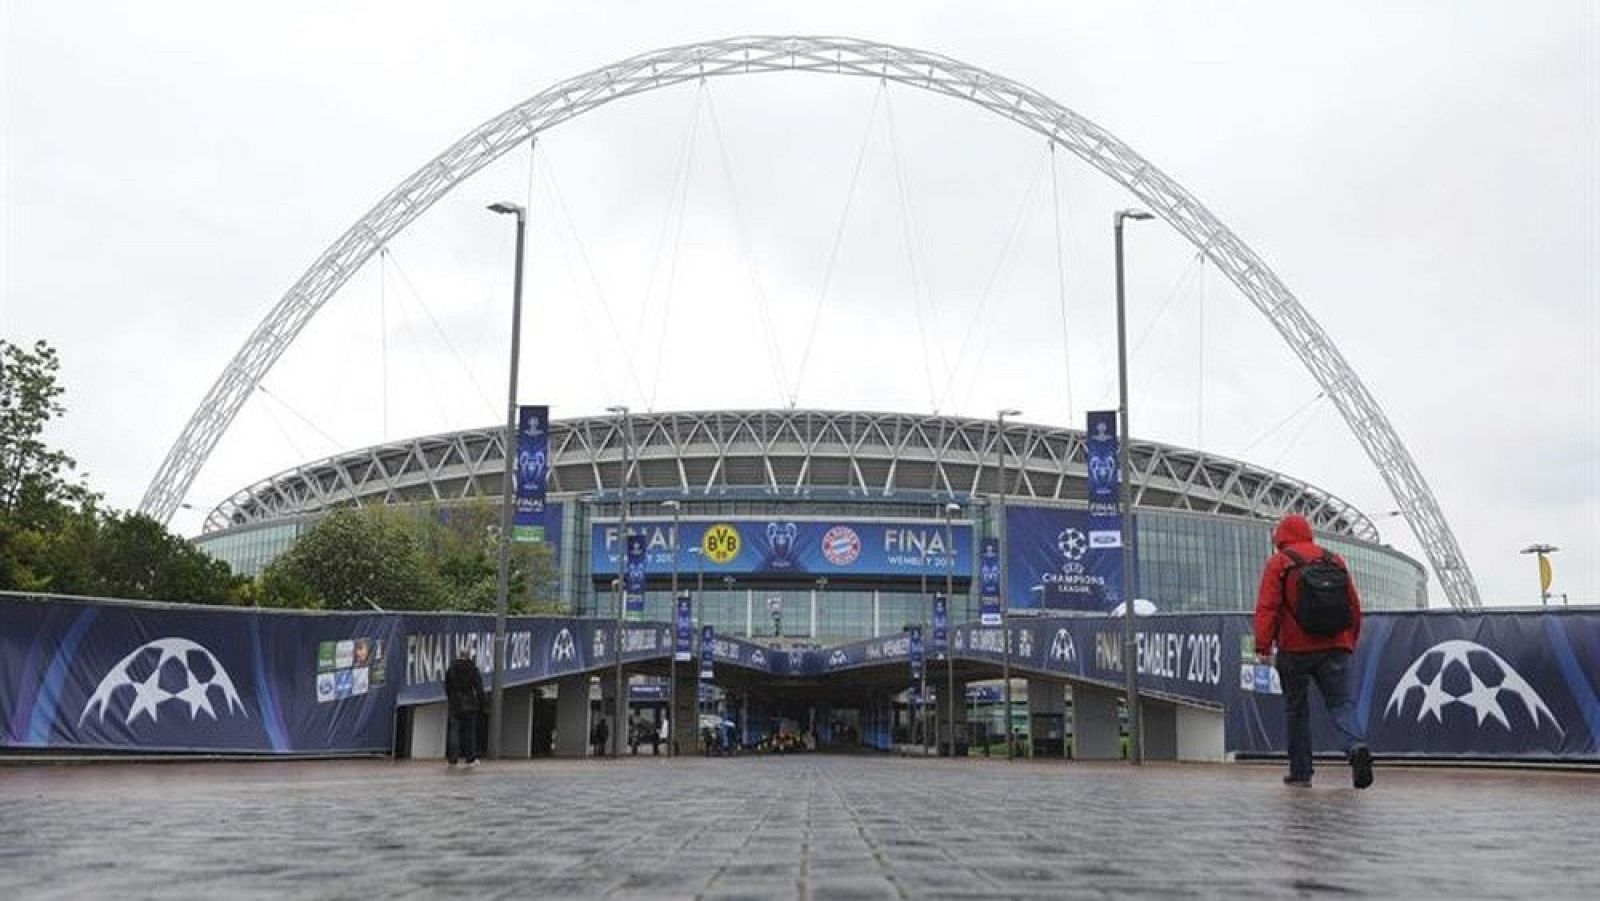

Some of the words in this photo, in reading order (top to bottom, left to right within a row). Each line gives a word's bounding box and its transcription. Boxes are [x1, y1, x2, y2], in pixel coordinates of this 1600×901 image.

[606, 527, 680, 551] FAL
[708, 528, 737, 552] BVB
[1136, 632, 1184, 678] EMBLEY
[1187, 634, 1221, 685] 2013
